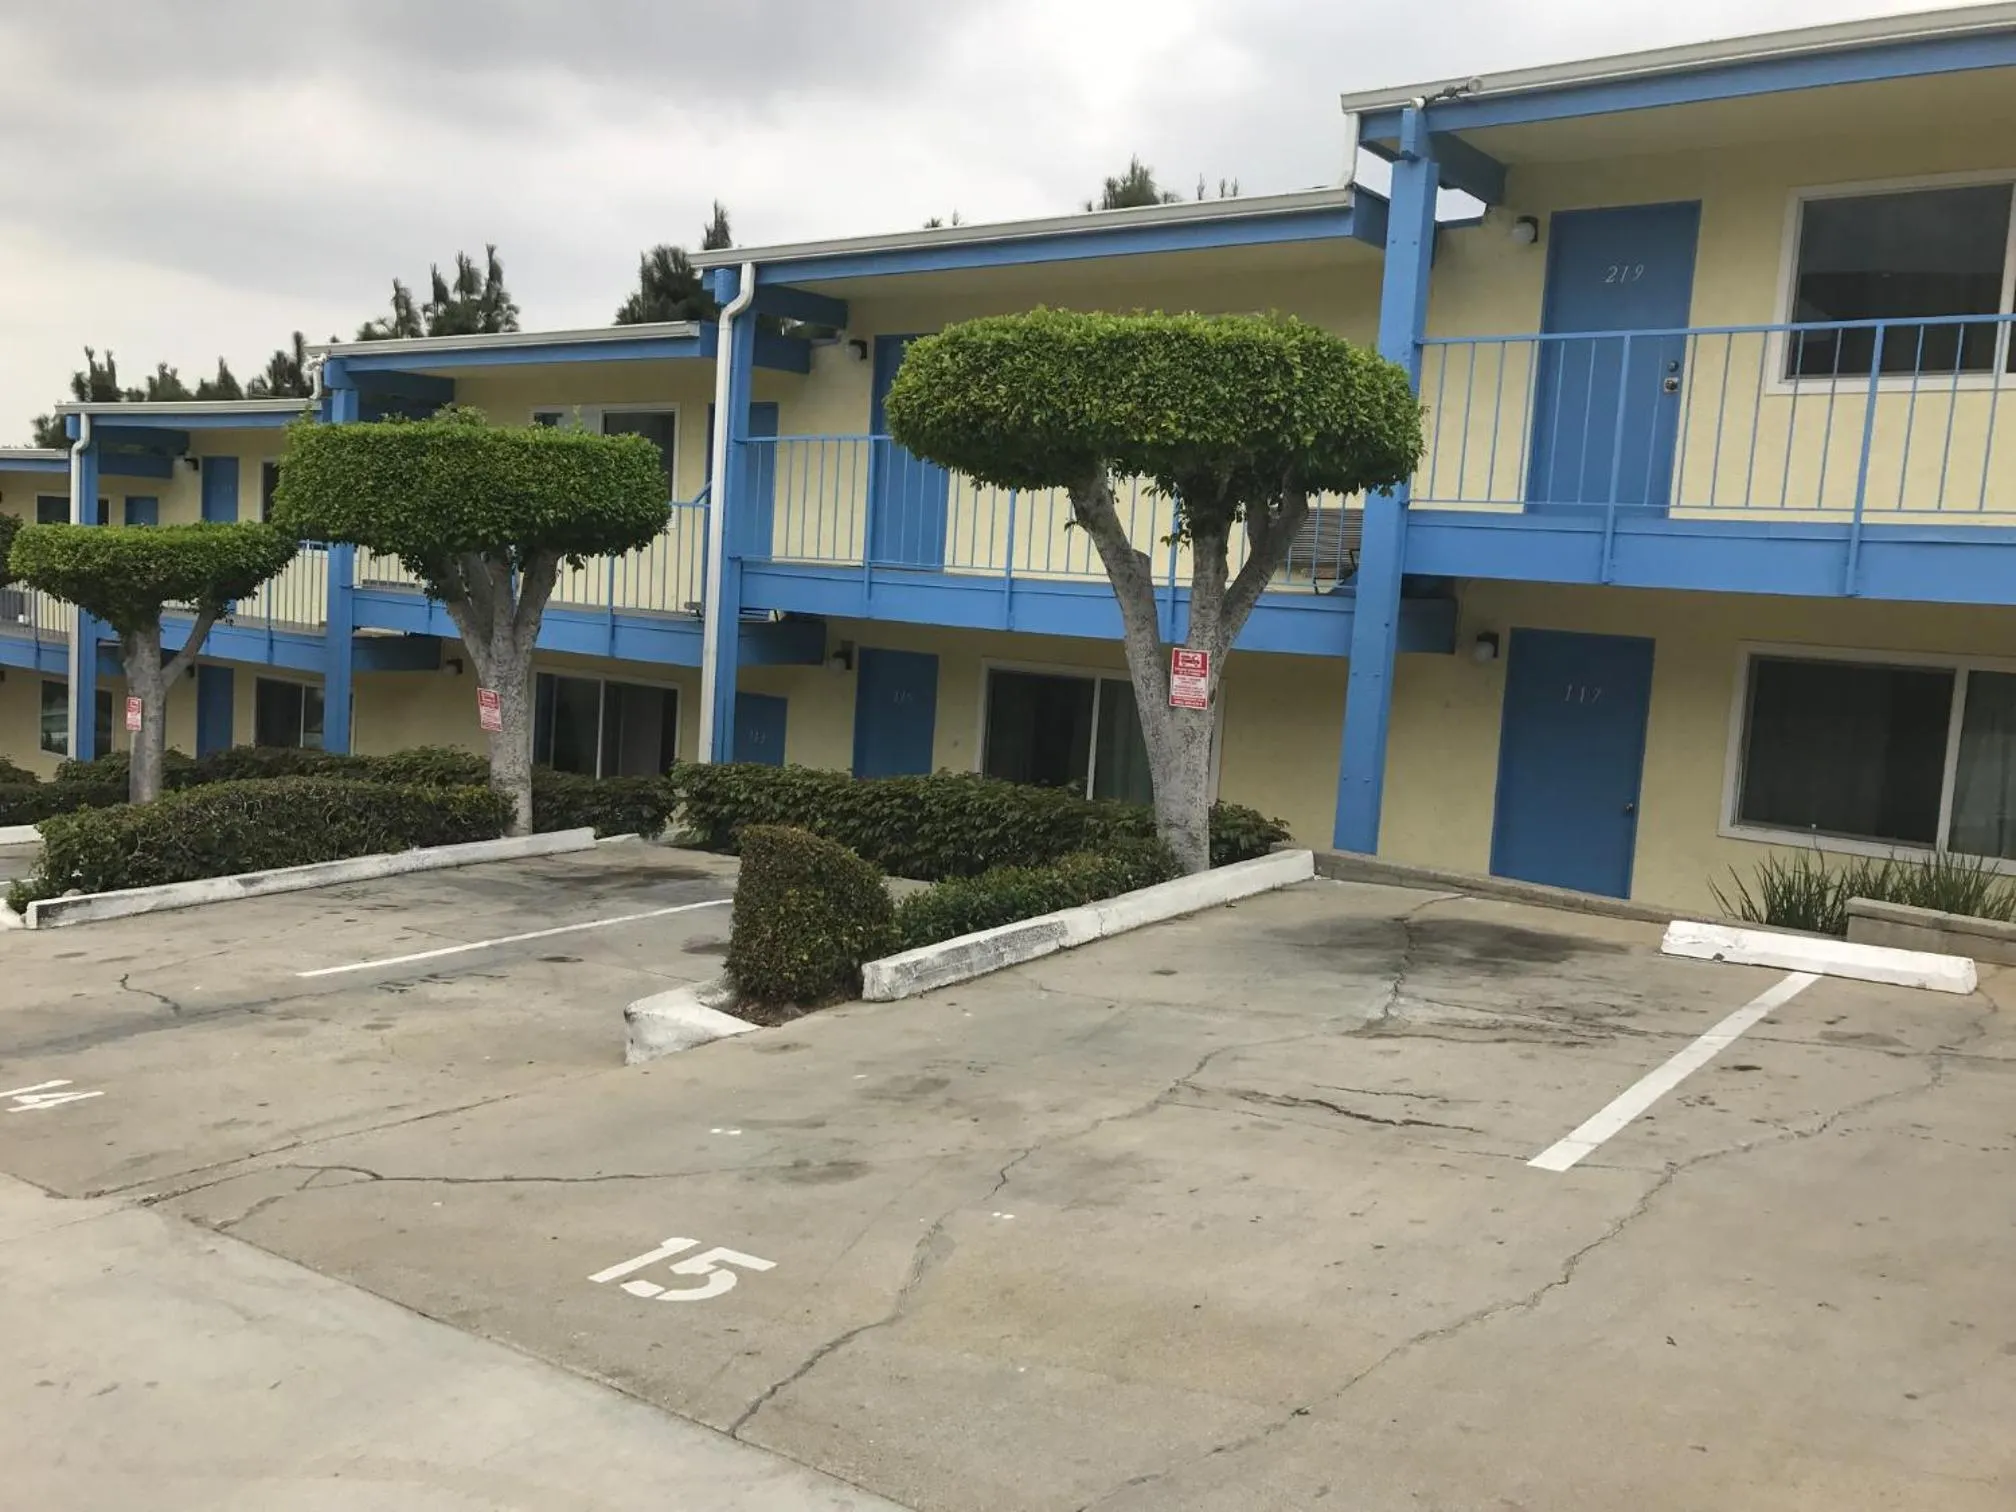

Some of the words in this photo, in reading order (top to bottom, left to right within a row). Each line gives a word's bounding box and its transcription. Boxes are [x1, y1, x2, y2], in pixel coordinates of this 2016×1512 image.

[1605, 264, 1644, 284] 219
[0, 1079, 105, 1112] 14
[587, 1237, 778, 1301] 15
